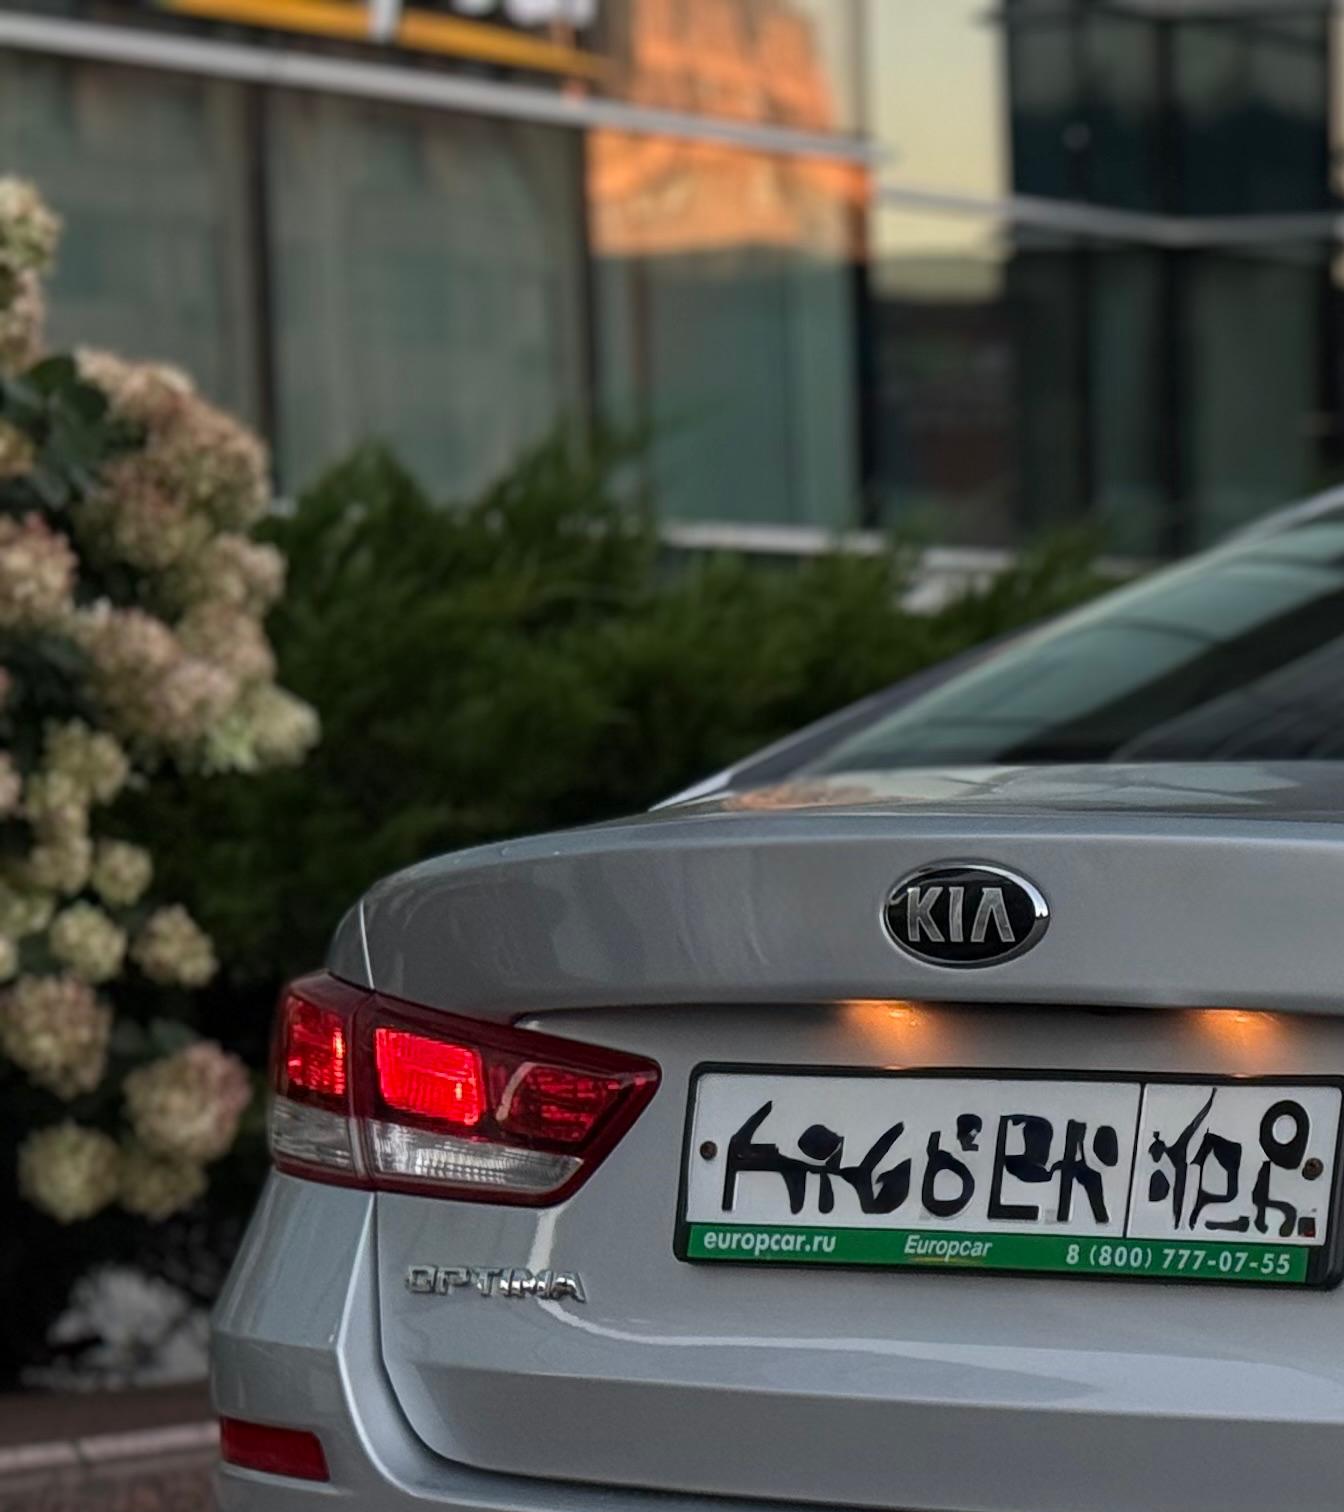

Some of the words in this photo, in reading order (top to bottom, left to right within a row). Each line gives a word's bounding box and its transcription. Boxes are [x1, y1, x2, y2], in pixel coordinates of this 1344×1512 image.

[907, 886, 1016, 943] KIA
[703, 1231, 837, 1254] europcar.ru
[903, 1234, 993, 1262] Europcar
[1065, 1244, 1080, 1265] 8
[1089, 1244, 1153, 1269] (800)
[1161, 1248, 1291, 1275] 777-07-55
